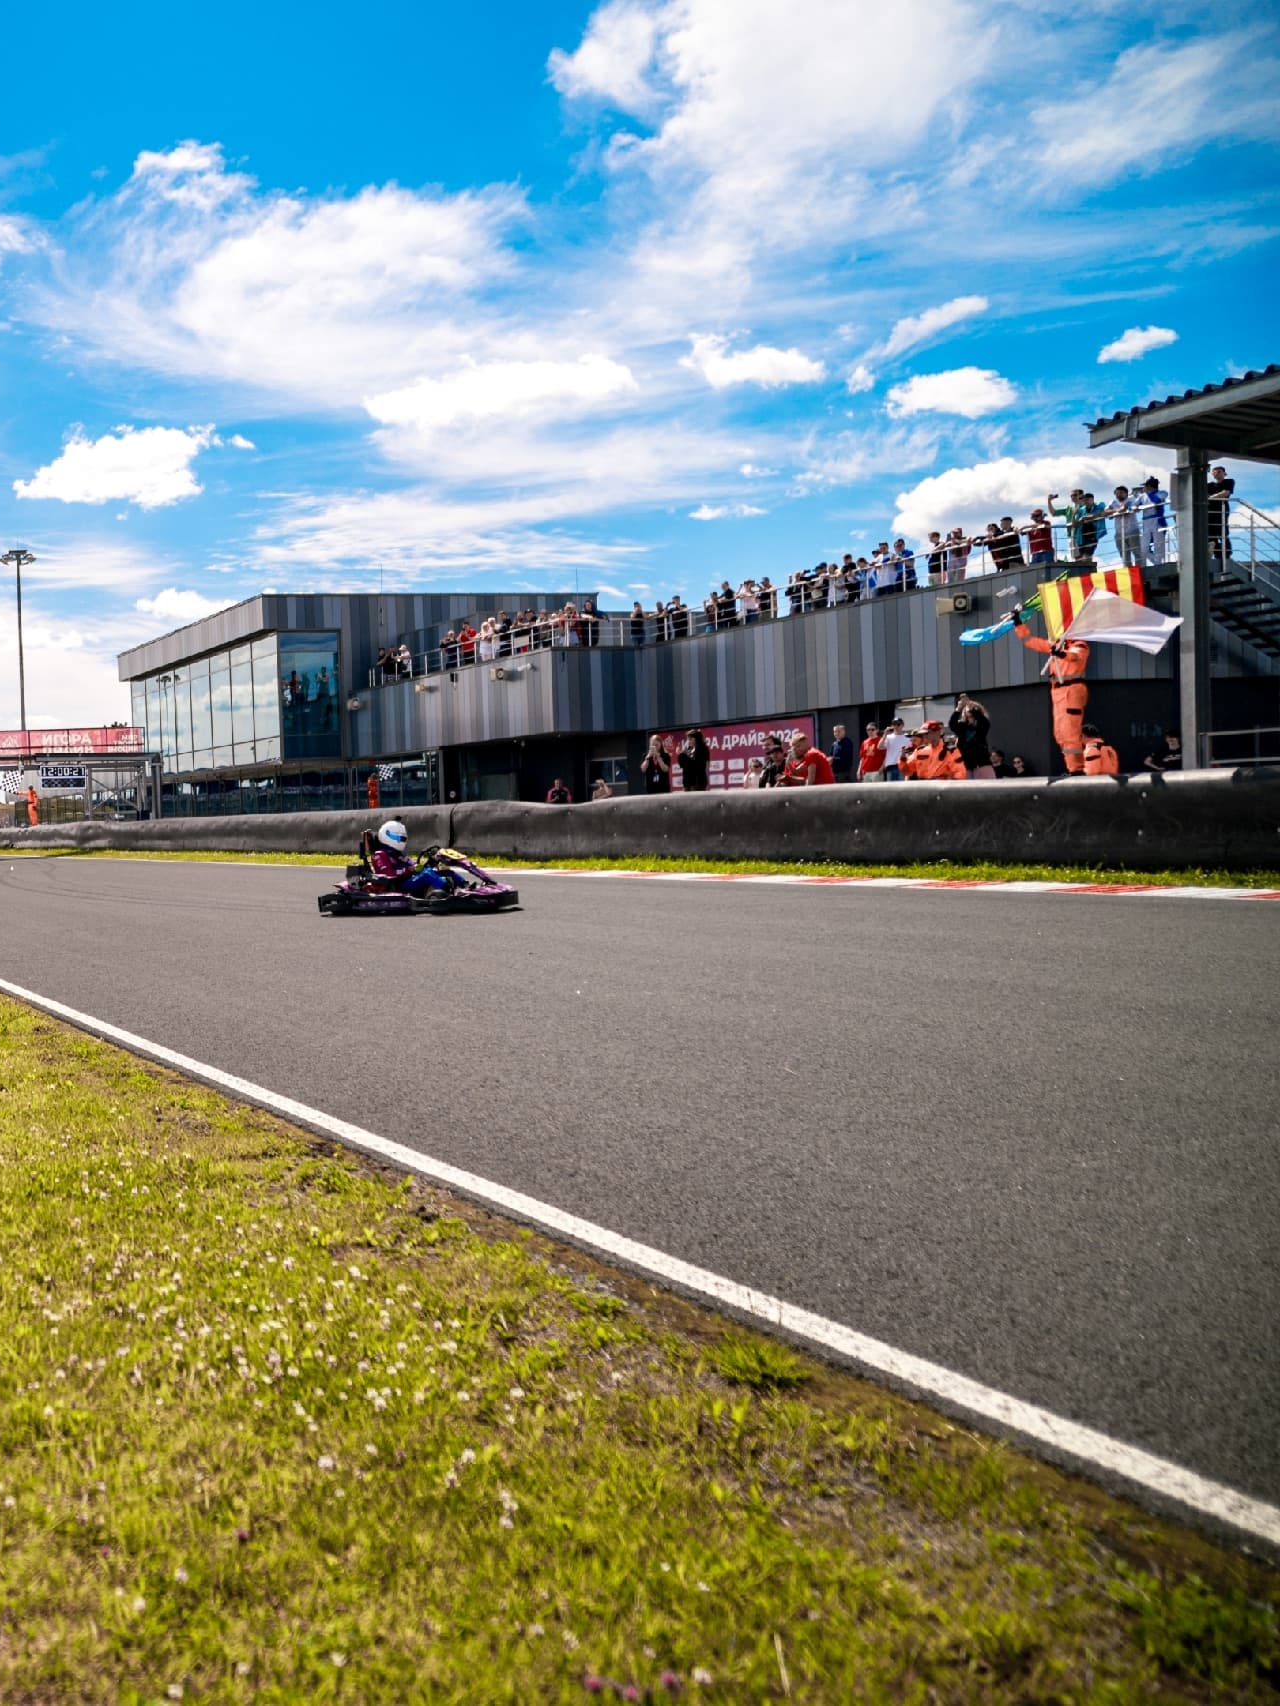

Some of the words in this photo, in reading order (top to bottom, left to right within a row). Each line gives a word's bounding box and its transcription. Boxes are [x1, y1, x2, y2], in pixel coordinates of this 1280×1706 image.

[41, 734, 92, 746] ИГОРА
[681, 737, 719, 752] ИРА
[721, 729, 765, 750] ДРАЙВ
[42, 767, 86, 777] 12:00:21
